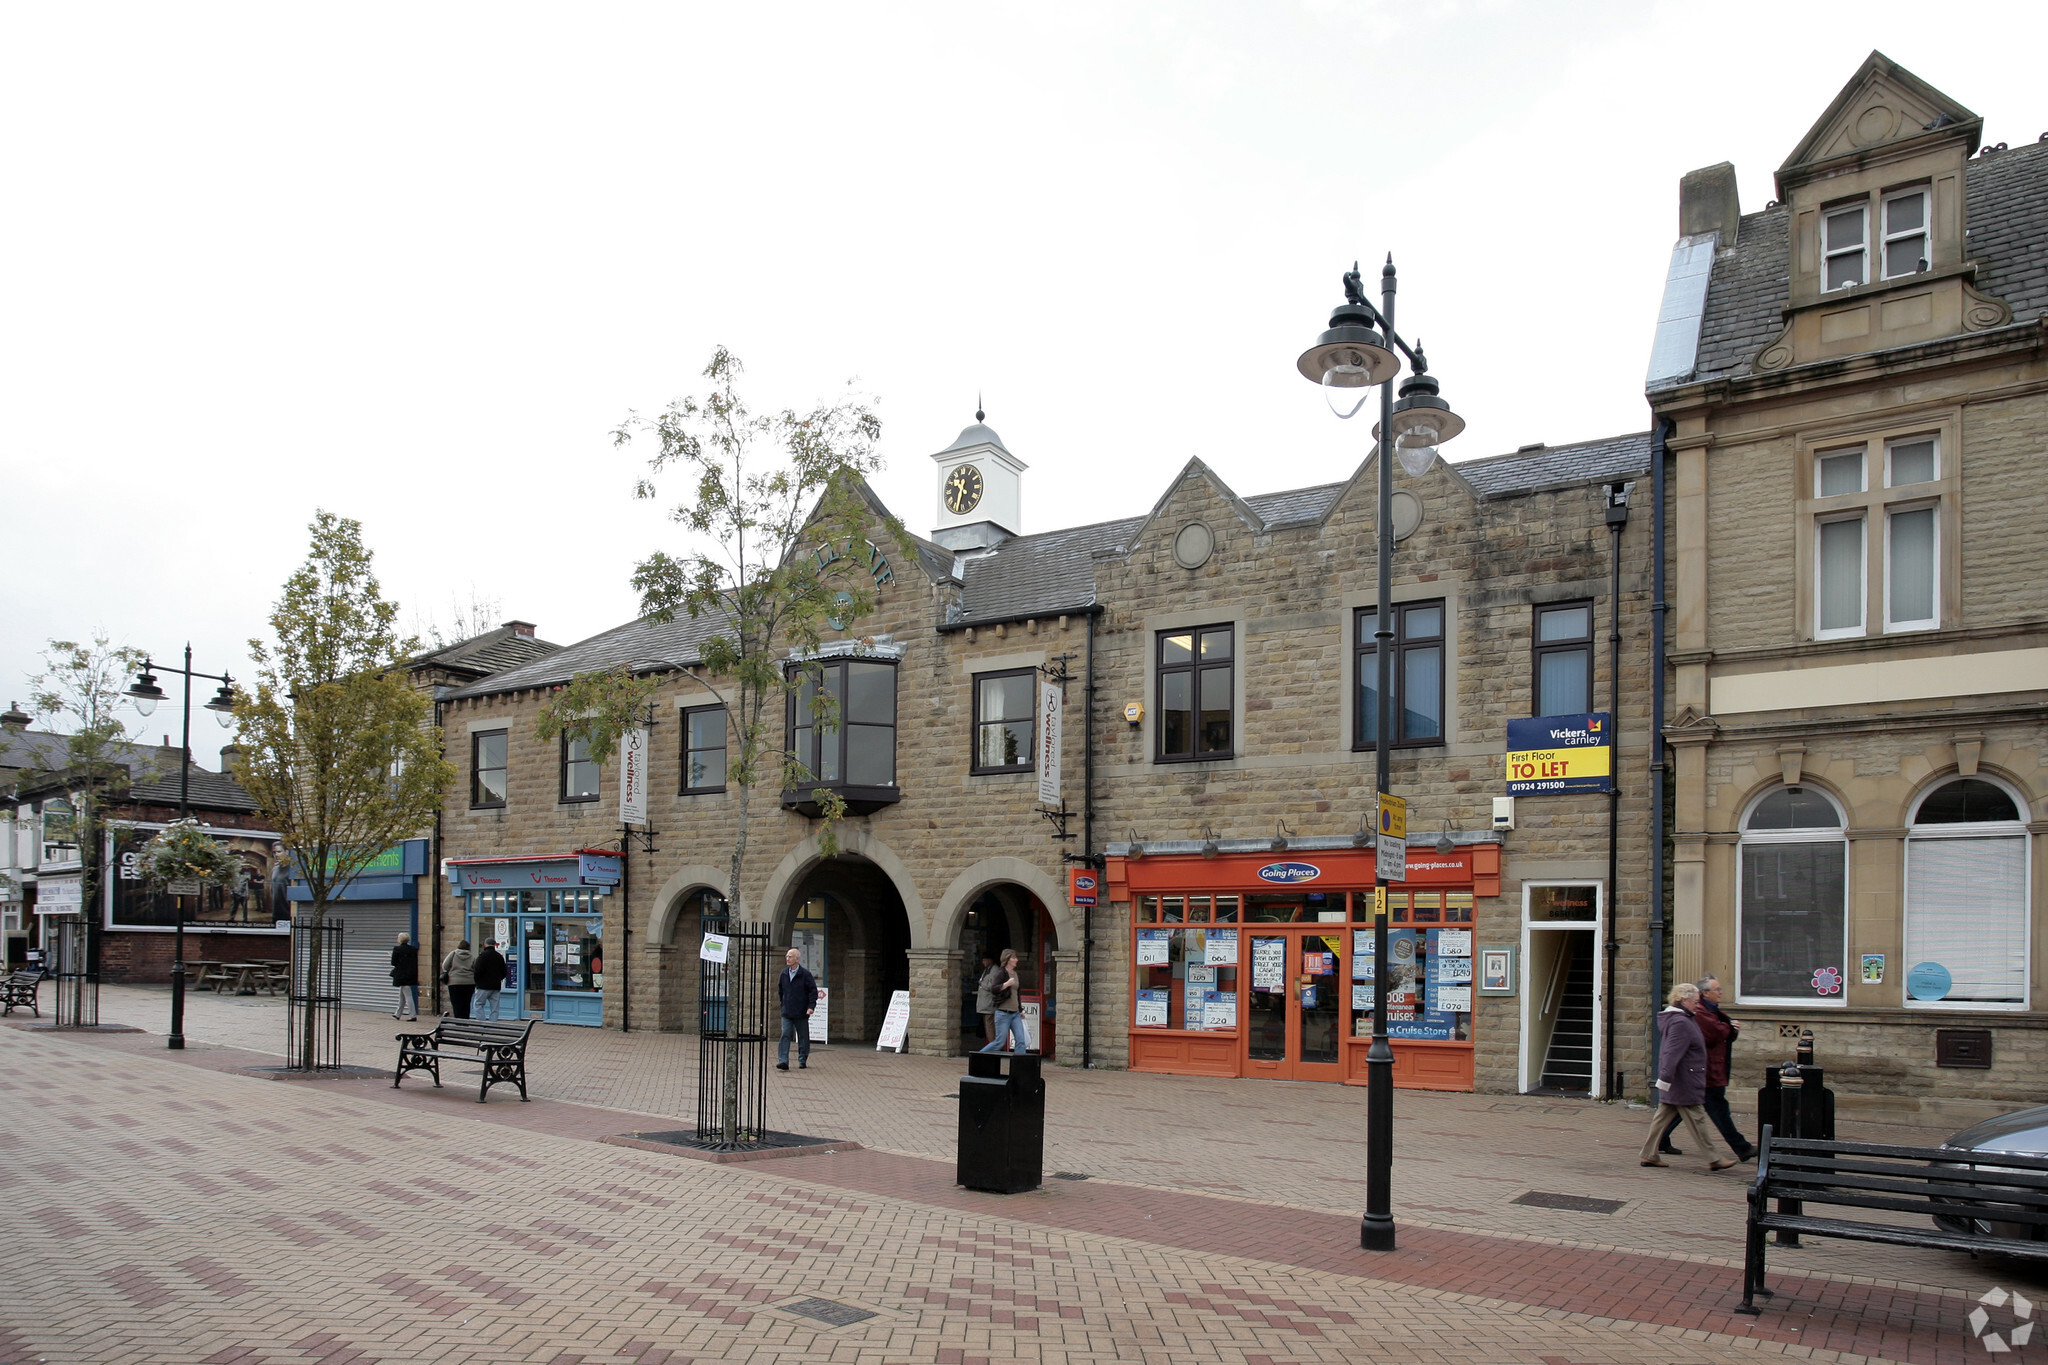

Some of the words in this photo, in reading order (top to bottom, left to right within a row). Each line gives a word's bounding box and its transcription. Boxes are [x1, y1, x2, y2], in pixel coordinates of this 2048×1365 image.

[1550, 728, 1586, 738] Vickers
[1564, 734, 1600, 746] carnley
[1512, 752, 1528, 762] First
[1532, 752, 1555, 760] Floor
[1512, 763, 1535, 778] TO
[1542, 762, 1569, 777] LET
[626, 751, 634, 803] wellness
[1512, 782, 1534, 790] 01924
[1537, 782, 1564, 790] 291500
[1262, 869, 1287, 878] Going
[1288, 868, 1315, 877] Places
[1399, 940, 1411, 948] FREE
[1387, 993, 1405, 1003] 008
[1387, 1010, 1414, 1021] ruises
[1396, 1025, 1422, 1034] Cruise
[1424, 1026, 1447, 1036] Store
